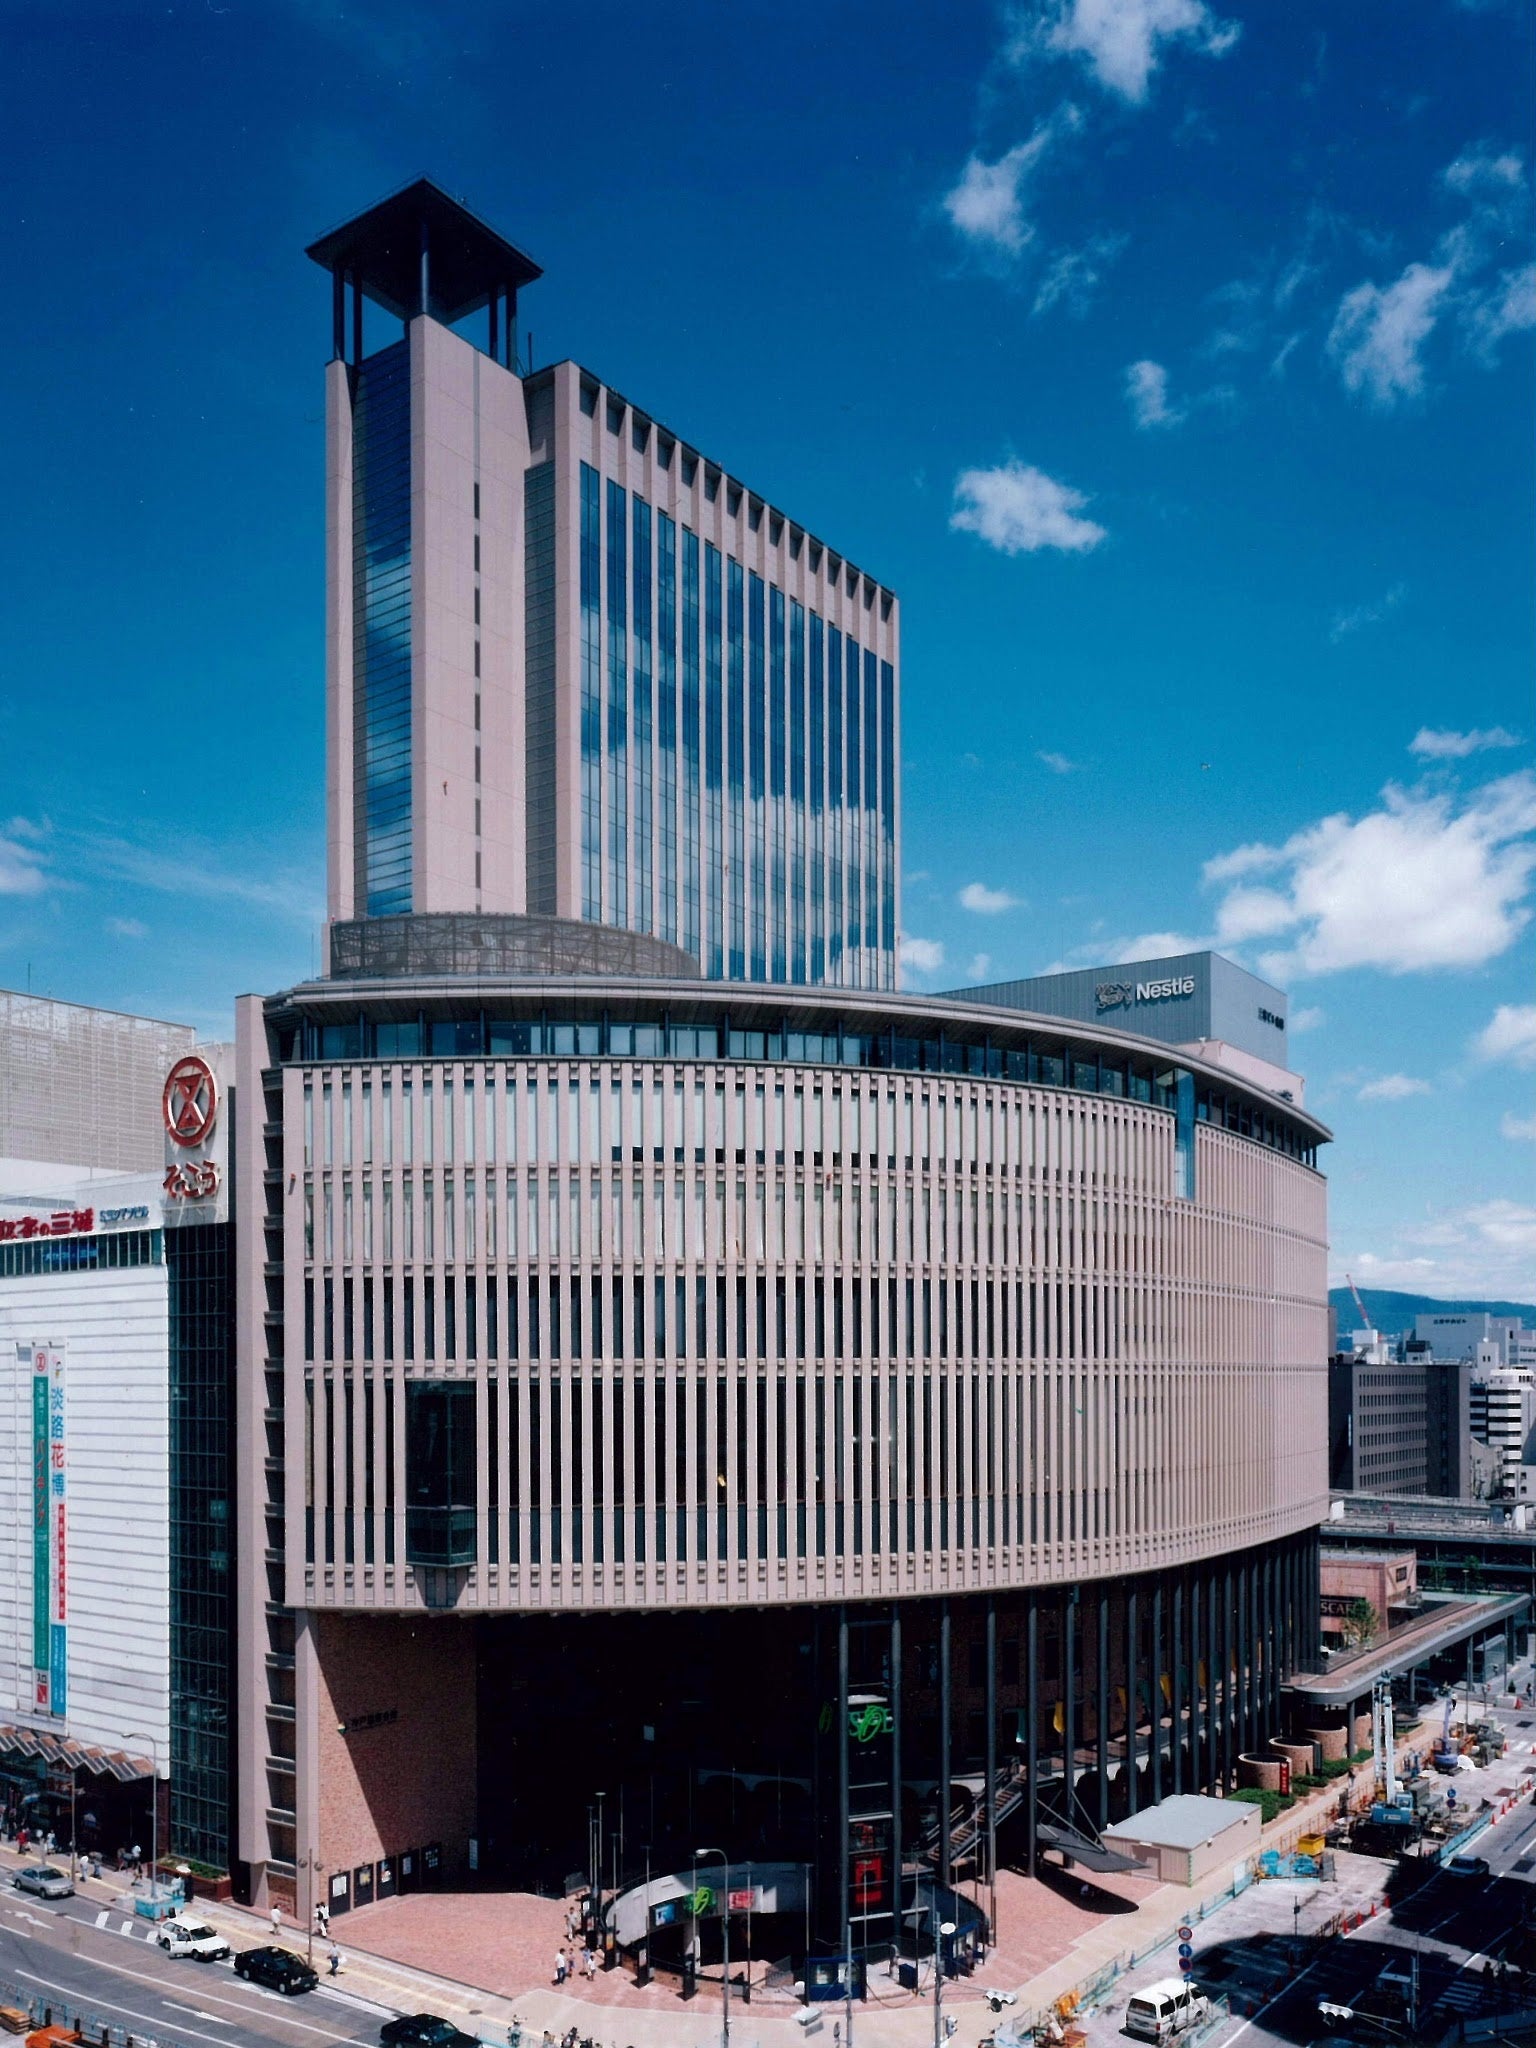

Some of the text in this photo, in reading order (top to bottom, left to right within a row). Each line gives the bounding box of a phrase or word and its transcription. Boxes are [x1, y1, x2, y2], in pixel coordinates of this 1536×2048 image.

[1136, 976, 1195, 1000] Nestlé
[163, 1160, 221, 1198] そごう
